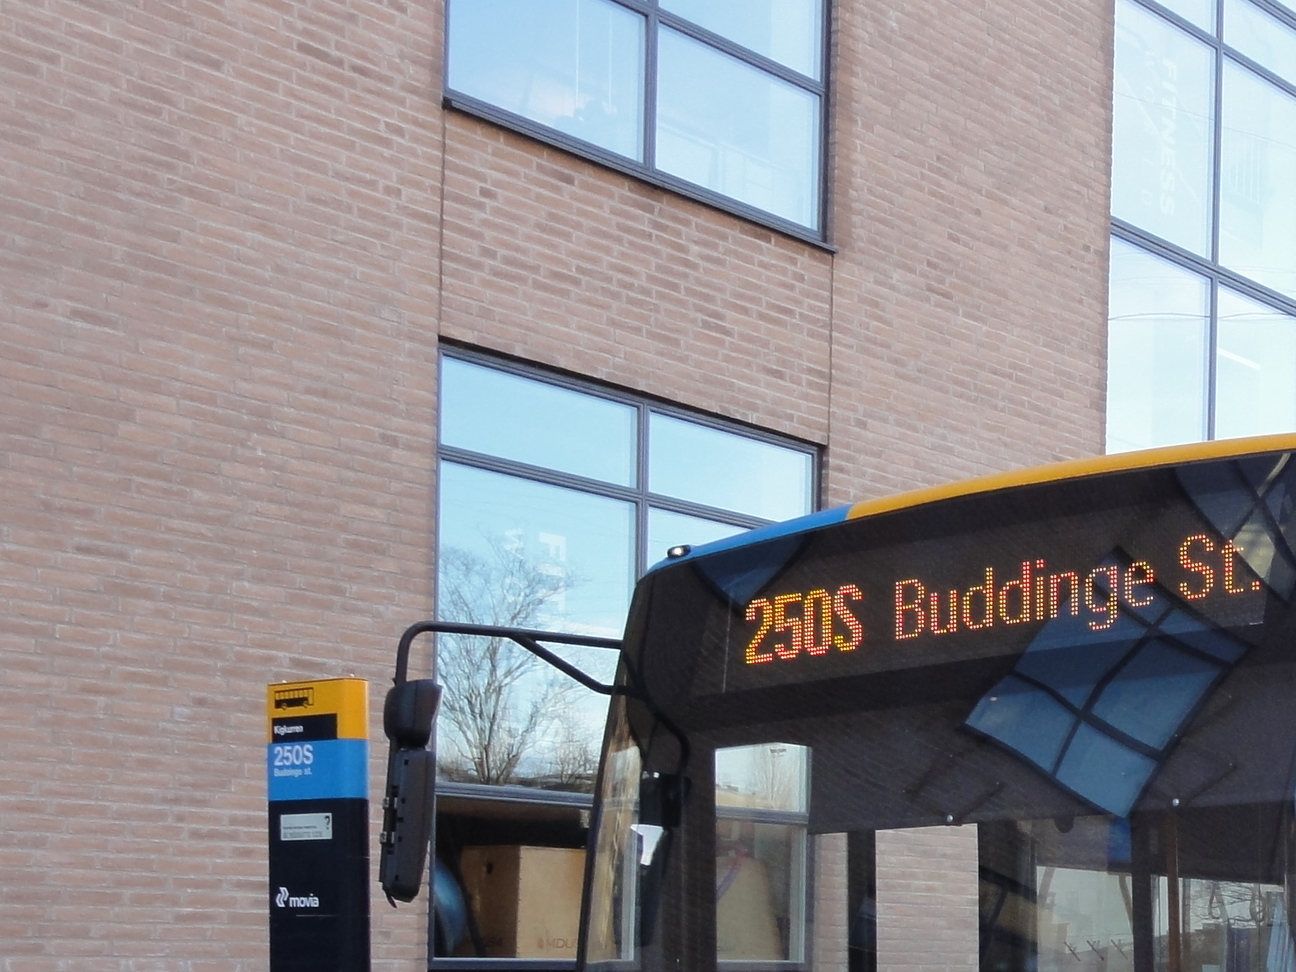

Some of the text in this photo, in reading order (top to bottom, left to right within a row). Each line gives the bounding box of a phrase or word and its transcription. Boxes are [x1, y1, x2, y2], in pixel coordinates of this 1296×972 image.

[745, 534, 1261, 665] 250S Buddinge St.
[273, 744, 314, 767] 250S
[289, 893, 319, 908] movia
